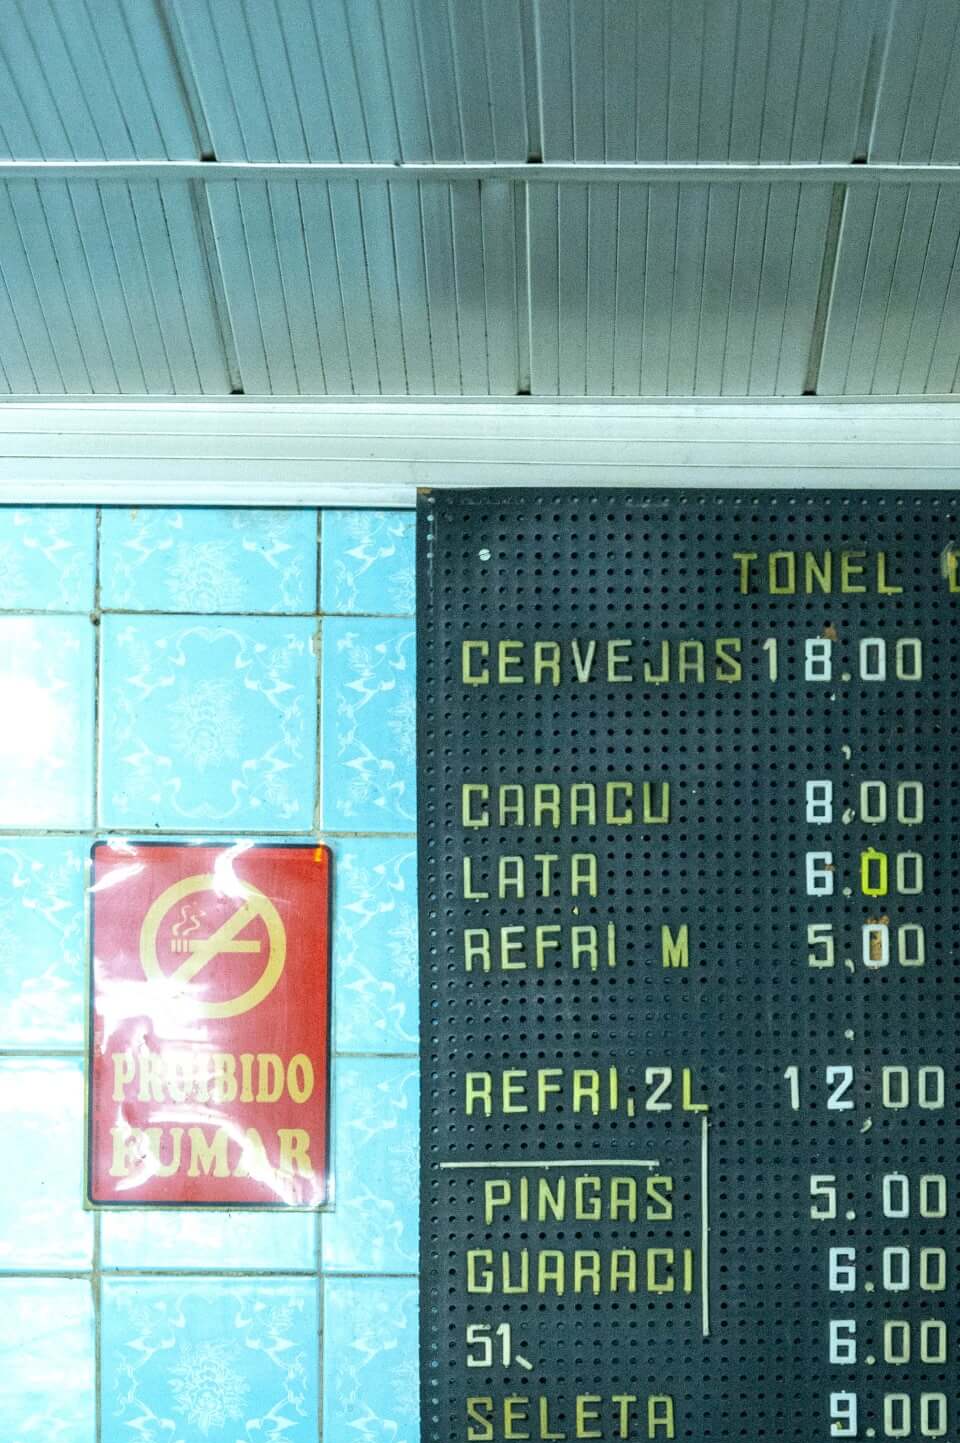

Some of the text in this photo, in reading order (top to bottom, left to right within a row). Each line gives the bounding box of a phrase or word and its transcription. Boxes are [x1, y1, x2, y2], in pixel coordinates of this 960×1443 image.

[733, 550, 902, 595] TONEL
[463, 639, 741, 686] CERVEJAS
[463, 782, 668, 829] CARACU
[464, 847, 922, 898] LATA 6.00
[464, 922, 615, 972] REFRI
[662, 925, 688, 967] M
[111, 1053, 315, 1103] PROIBIDO
[485, 1174, 672, 1224] PINGAS
[467, 1247, 945, 1295] GUARACI 6.00
[830, 1319, 946, 1365] 6.00
[467, 1390, 946, 1440] SELETA 9.00
